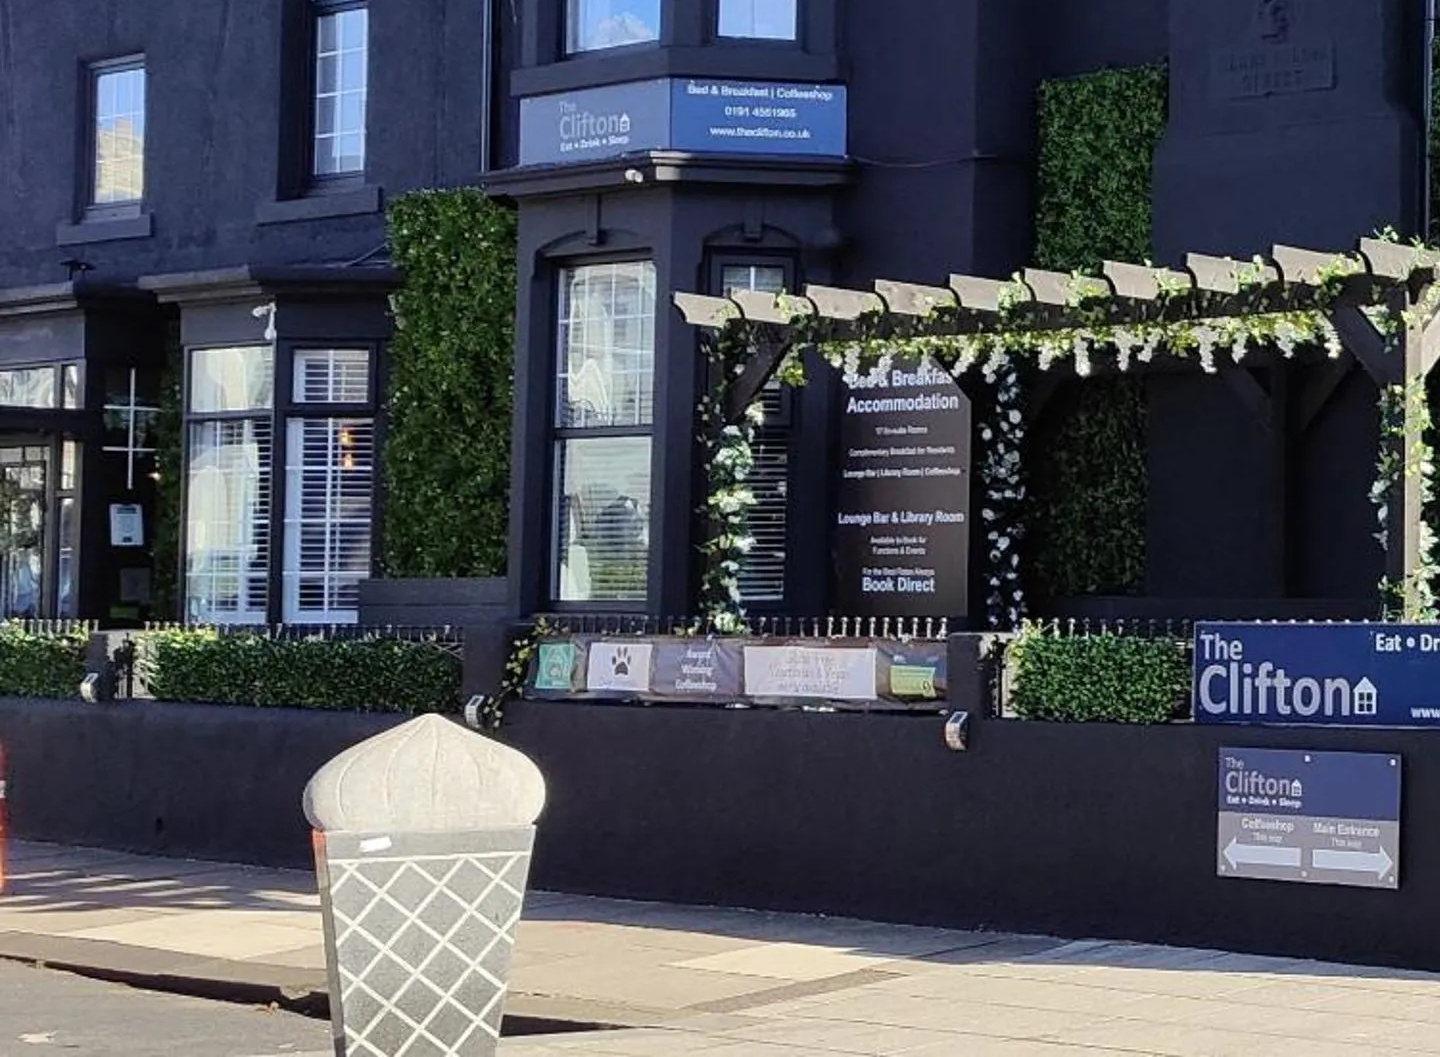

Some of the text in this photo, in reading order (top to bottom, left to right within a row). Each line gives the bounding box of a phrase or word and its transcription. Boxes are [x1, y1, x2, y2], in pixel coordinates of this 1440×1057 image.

[560, 112, 618, 140] Clifton
[892, 368, 953, 387] Breakfas
[846, 392, 959, 414] Accommodation
[838, 512, 872, 526] Lounge
[873, 511, 890, 523] Bar
[900, 510, 933, 526] Library
[934, 510, 965, 523] Room
[862, 576, 935, 593] Book Direct
[1200, 632, 1243, 660] The
[1375, 633, 1402, 653] Eat
[1200, 661, 1350, 716] Clifton
[1225, 756, 1244, 769] The
[1225, 770, 1290, 796] Clifton
